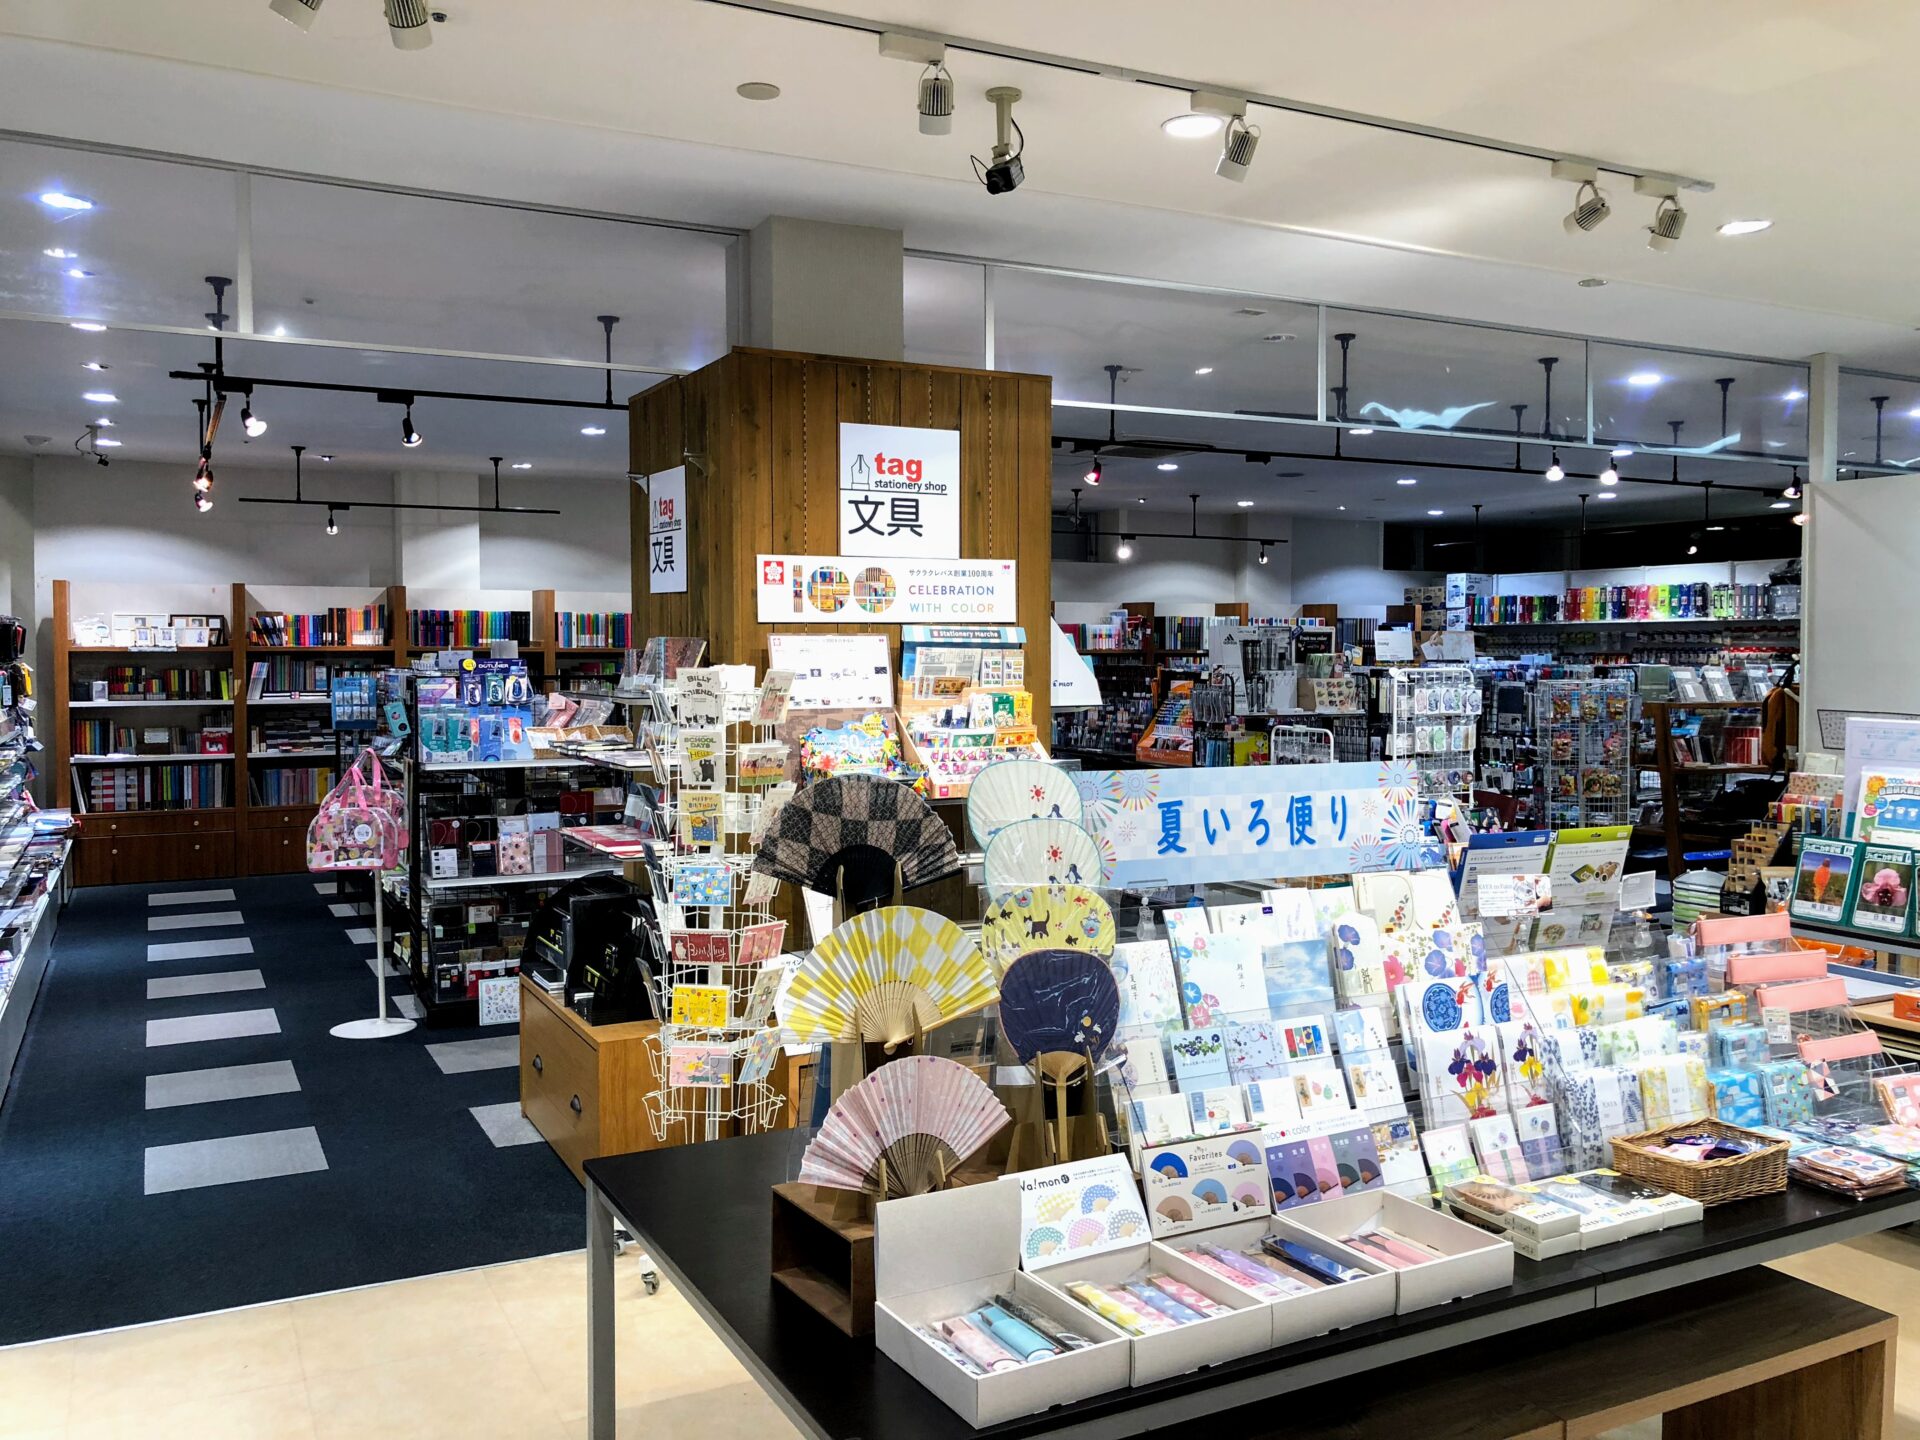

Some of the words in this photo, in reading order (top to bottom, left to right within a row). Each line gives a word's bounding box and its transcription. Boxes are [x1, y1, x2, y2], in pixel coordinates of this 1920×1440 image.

[874, 452, 923, 482] tag
[874, 479, 923, 492] stationery
[924, 481, 948, 493] shop
[659, 497, 674, 520] tag
[848, 495, 923, 537] 文具
[652, 536, 675, 574] 文具
[908, 585, 994, 596] CELEBRATION
[910, 604, 942, 613] WITH
[951, 604, 994, 613] COLOR
[687, 675, 712, 683] BILLY
[1157, 794, 1349, 856] 夏いろ便り
[1292, 1124, 1311, 1135] color
[1189, 1150, 1223, 1162] Favorites
